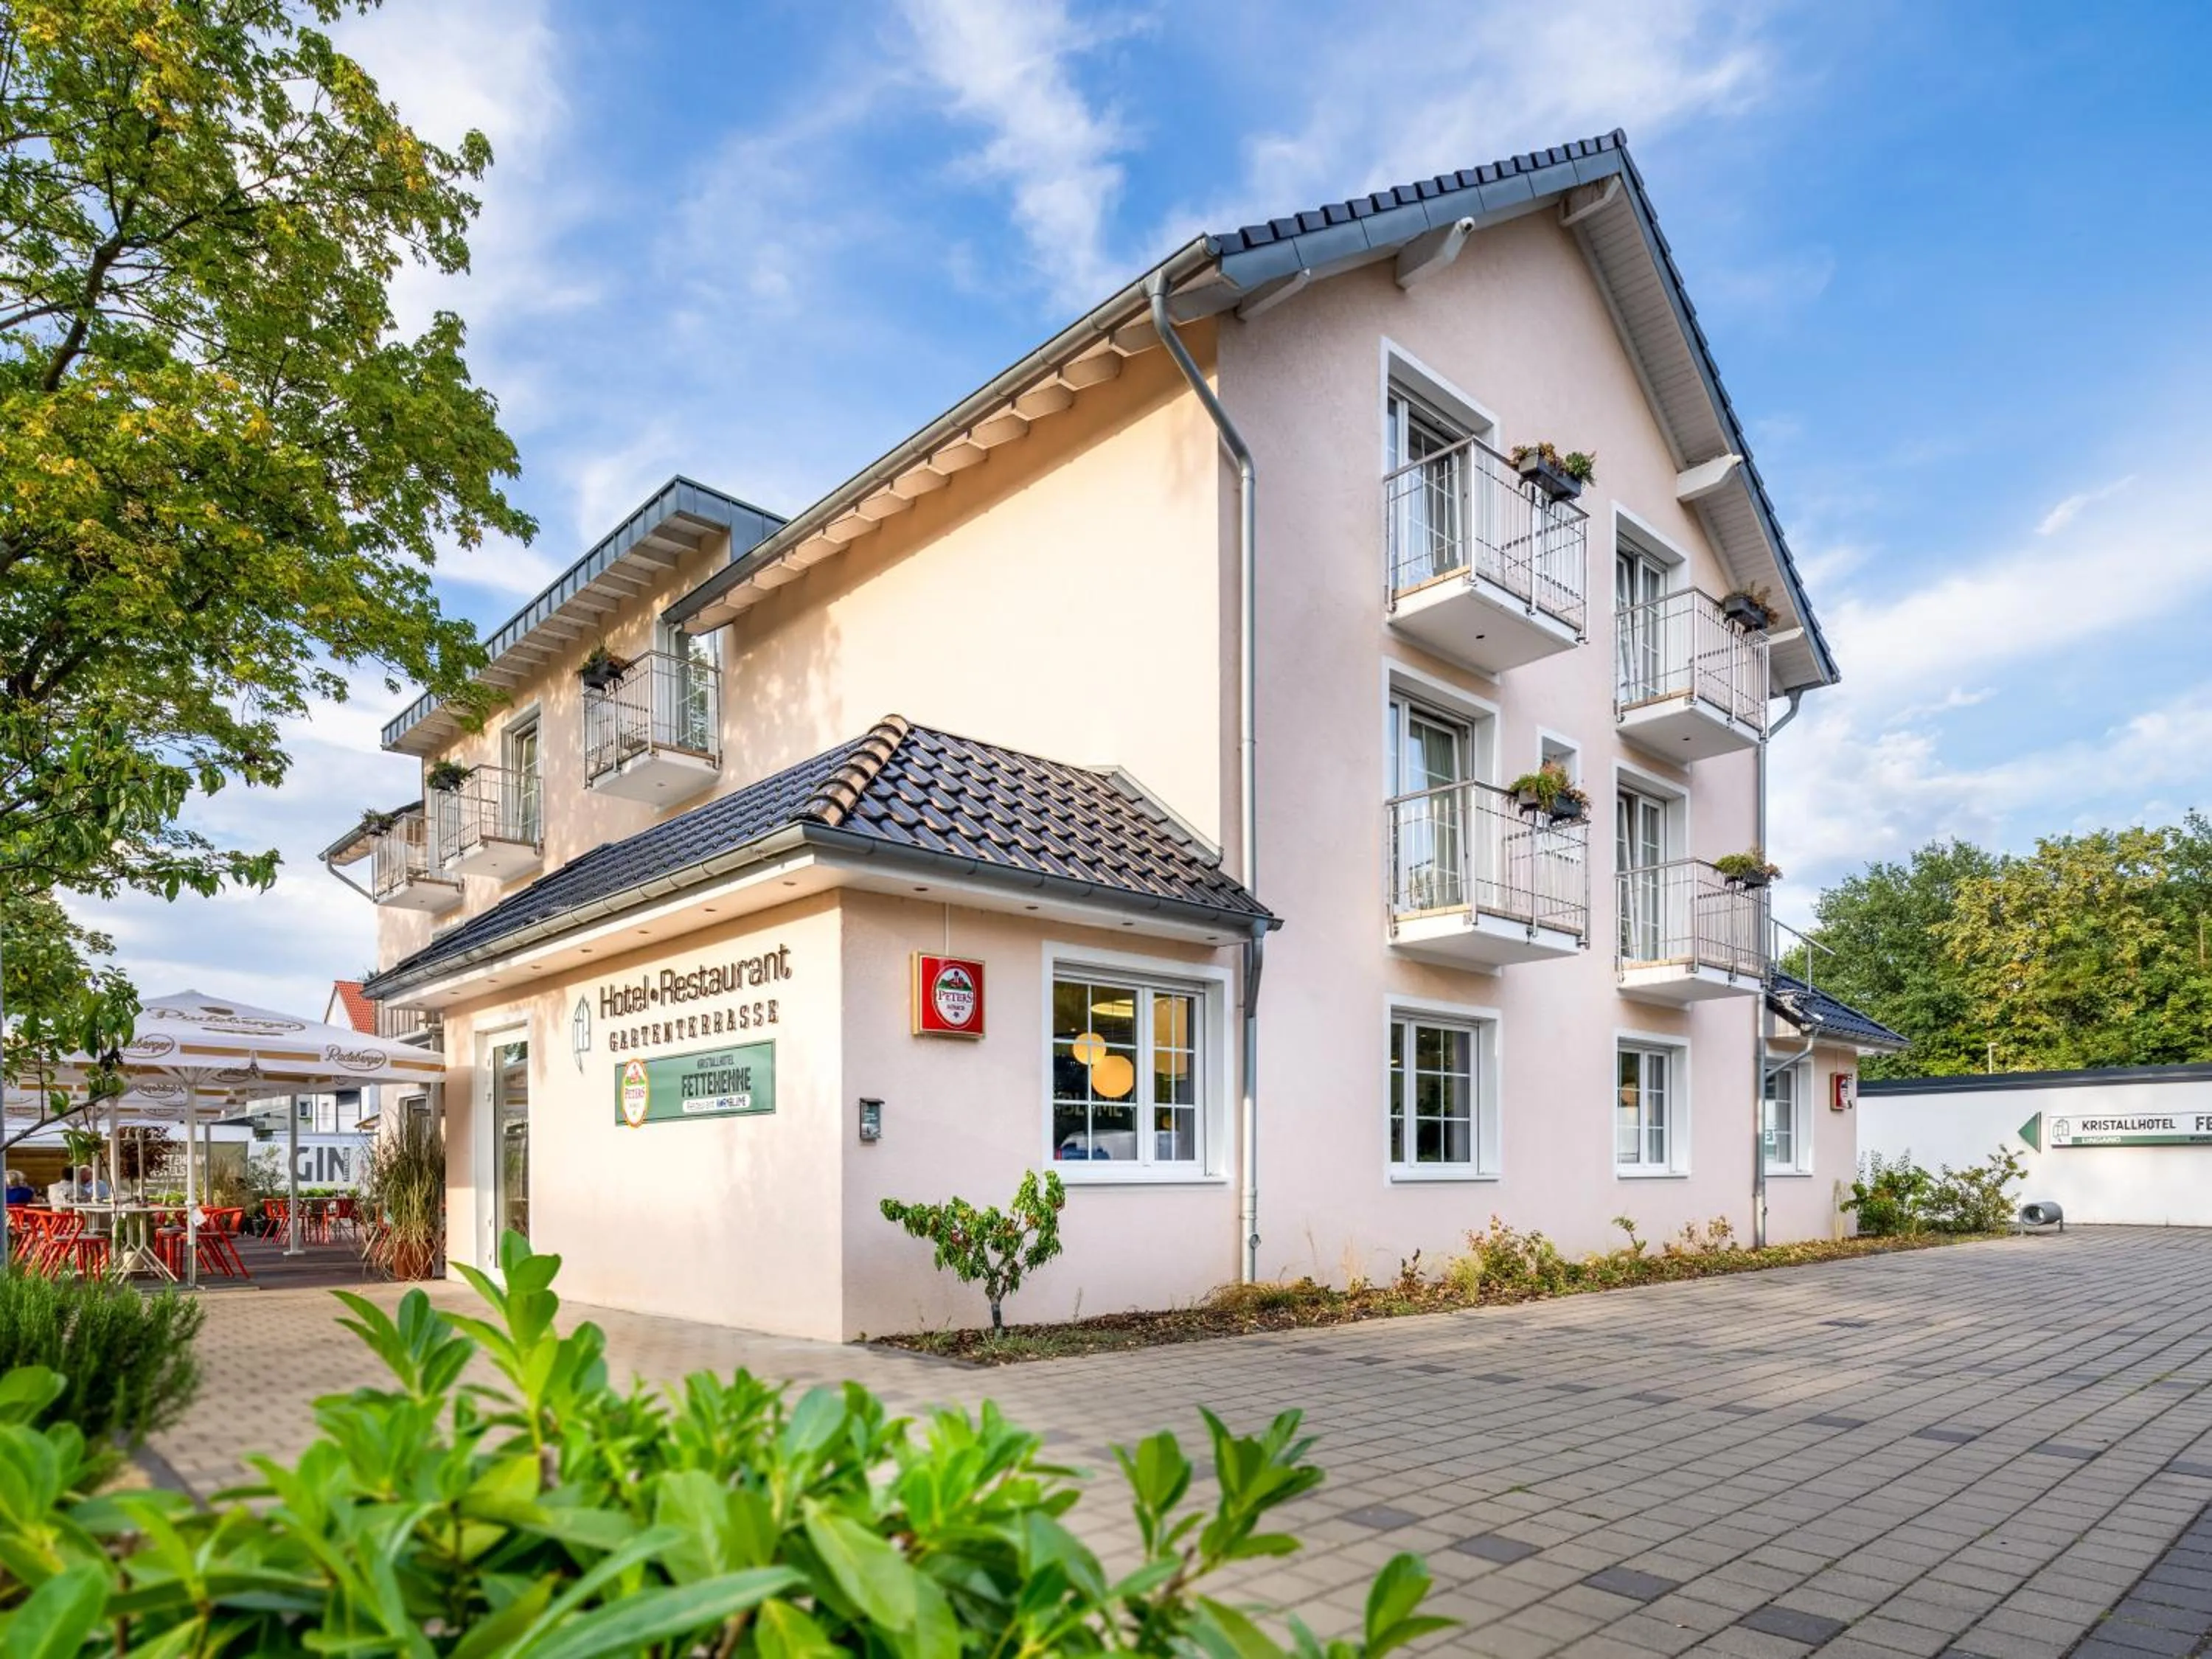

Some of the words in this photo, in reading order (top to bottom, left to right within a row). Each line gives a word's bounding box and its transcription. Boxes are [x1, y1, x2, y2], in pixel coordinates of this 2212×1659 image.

[599, 975, 650, 1019] Hotel
[660, 943, 793, 1006] Restaurant
[938, 990, 973, 1004] PETERS
[609, 999, 779, 1052] GARTENTERRASSE
[325, 1044, 386, 1070] Radeberger
[681, 1067, 751, 1098] FETTEHENNE
[2081, 1118, 2177, 1131] KRISTALLHOTEL
[289, 1147, 350, 1182] GIN
